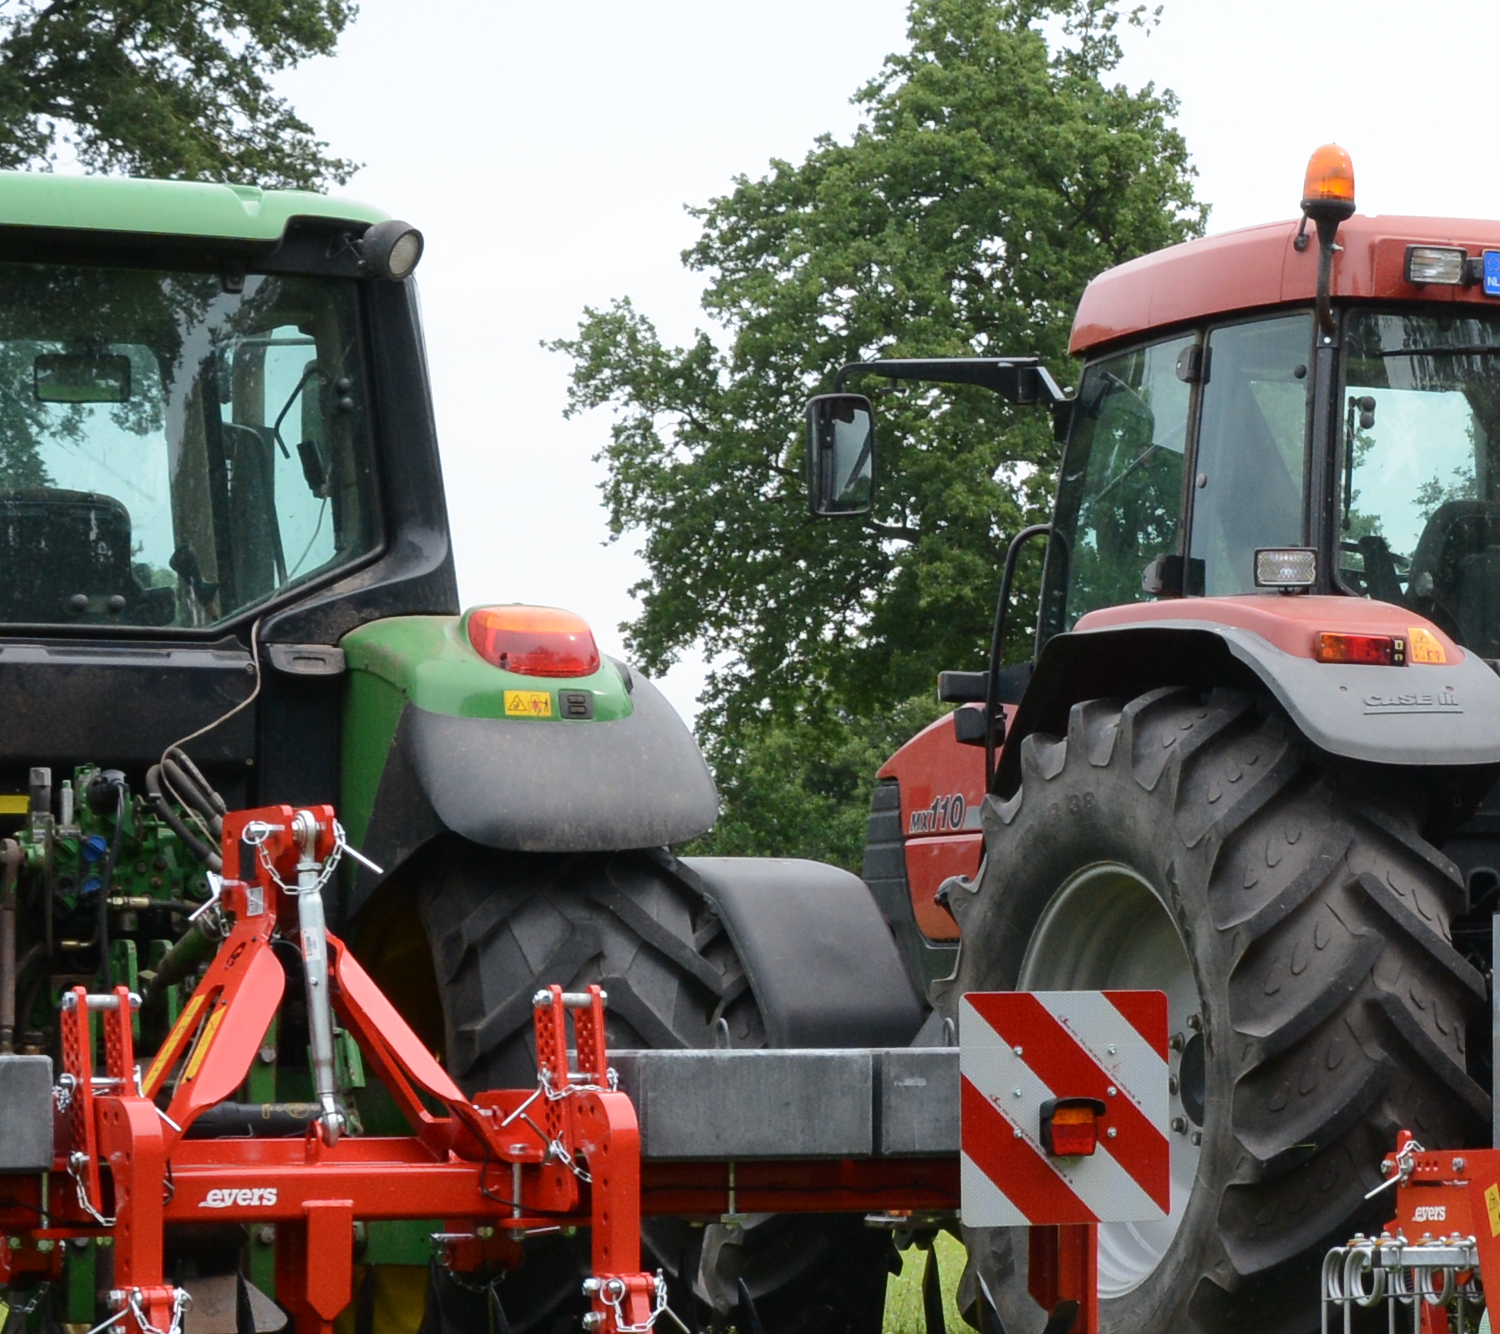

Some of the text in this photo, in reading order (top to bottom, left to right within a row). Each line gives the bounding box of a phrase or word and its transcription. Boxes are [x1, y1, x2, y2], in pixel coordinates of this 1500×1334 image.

[1486, 276, 1500, 287] NL
[1363, 693, 1433, 707] CASE
[909, 793, 966, 834] MX110
[204, 1187, 278, 1207] evers
[1414, 1206, 1447, 1222] evers
